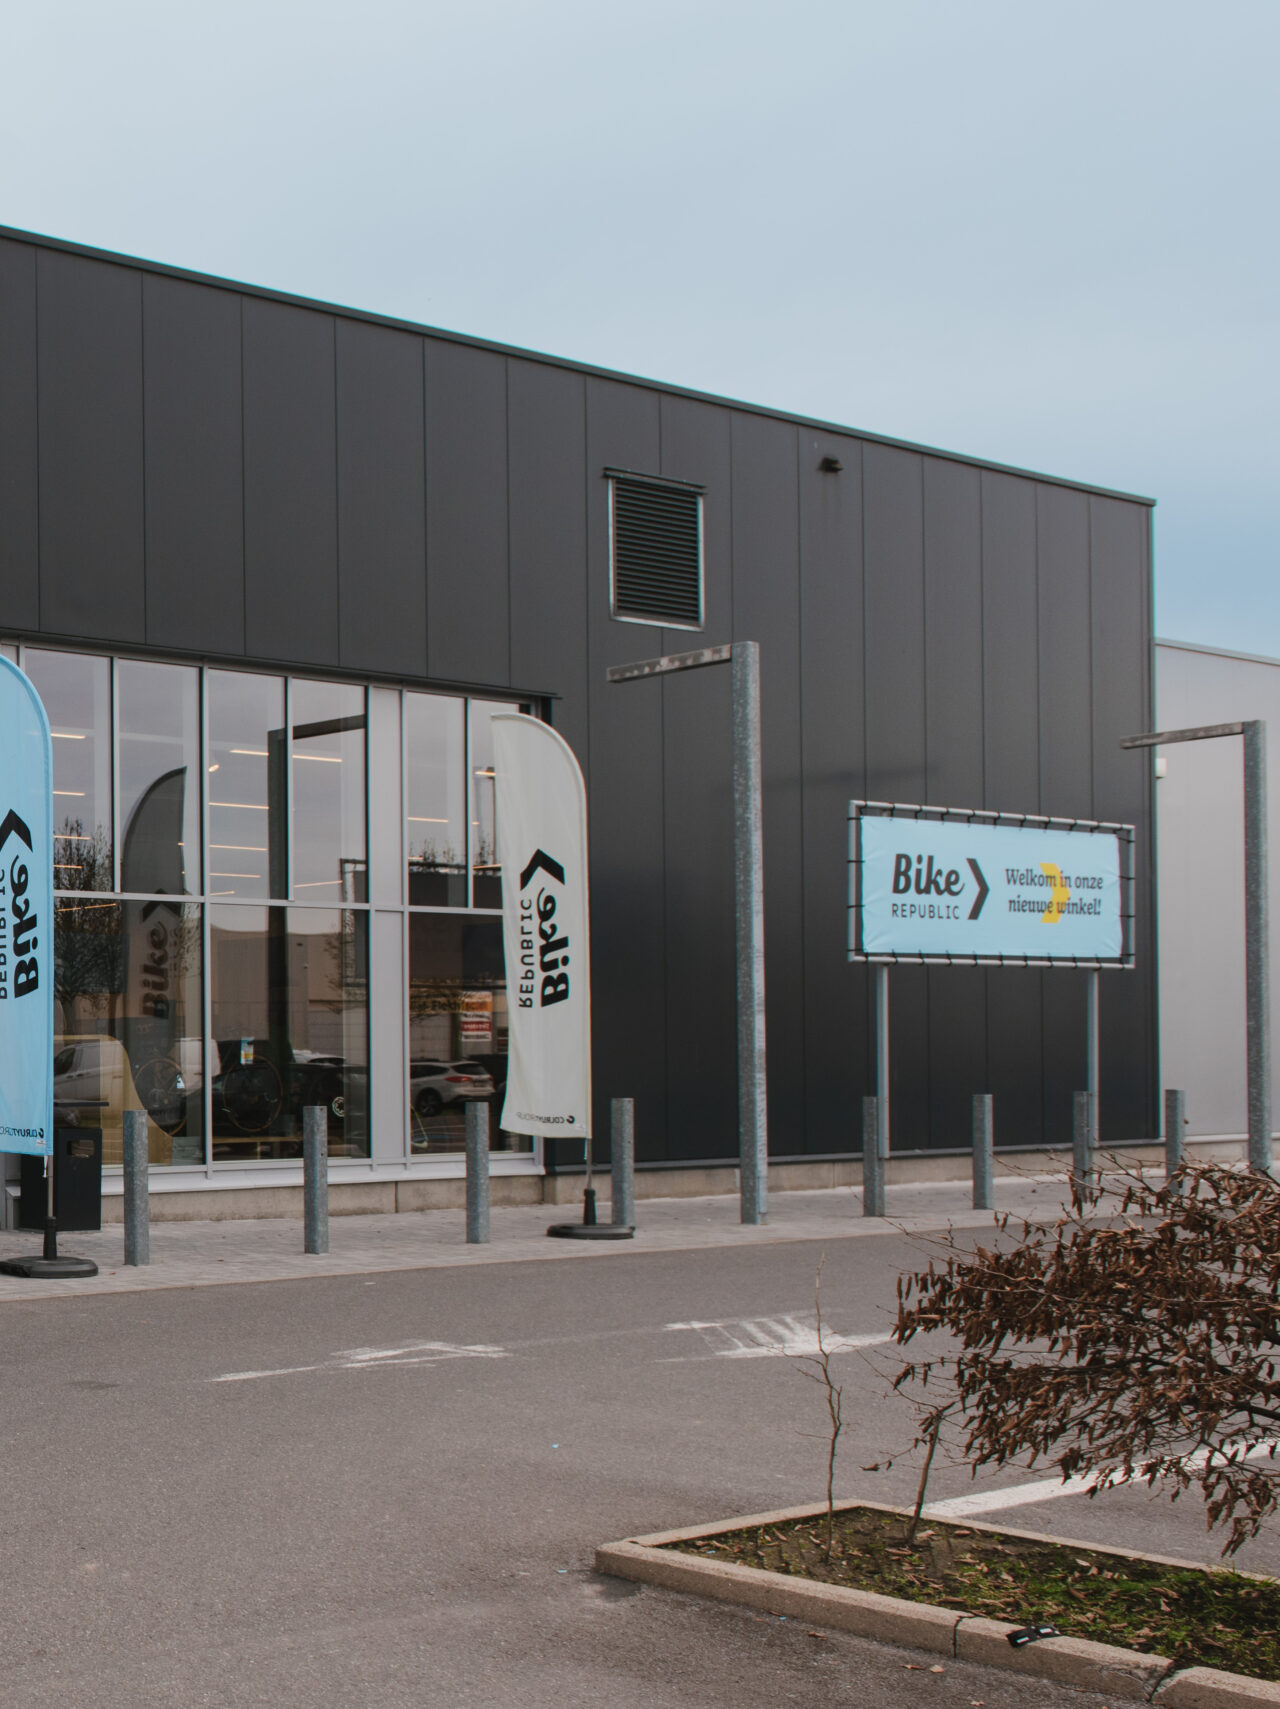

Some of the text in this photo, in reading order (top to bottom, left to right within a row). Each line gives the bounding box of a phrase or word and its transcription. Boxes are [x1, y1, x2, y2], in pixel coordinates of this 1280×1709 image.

[891, 853, 965, 897] Bike
[1005, 868, 1104, 890] Welkom in onze
[891, 903, 960, 920] REPUBLIC
[1008, 896, 1102, 916] nieuwe winkel!
